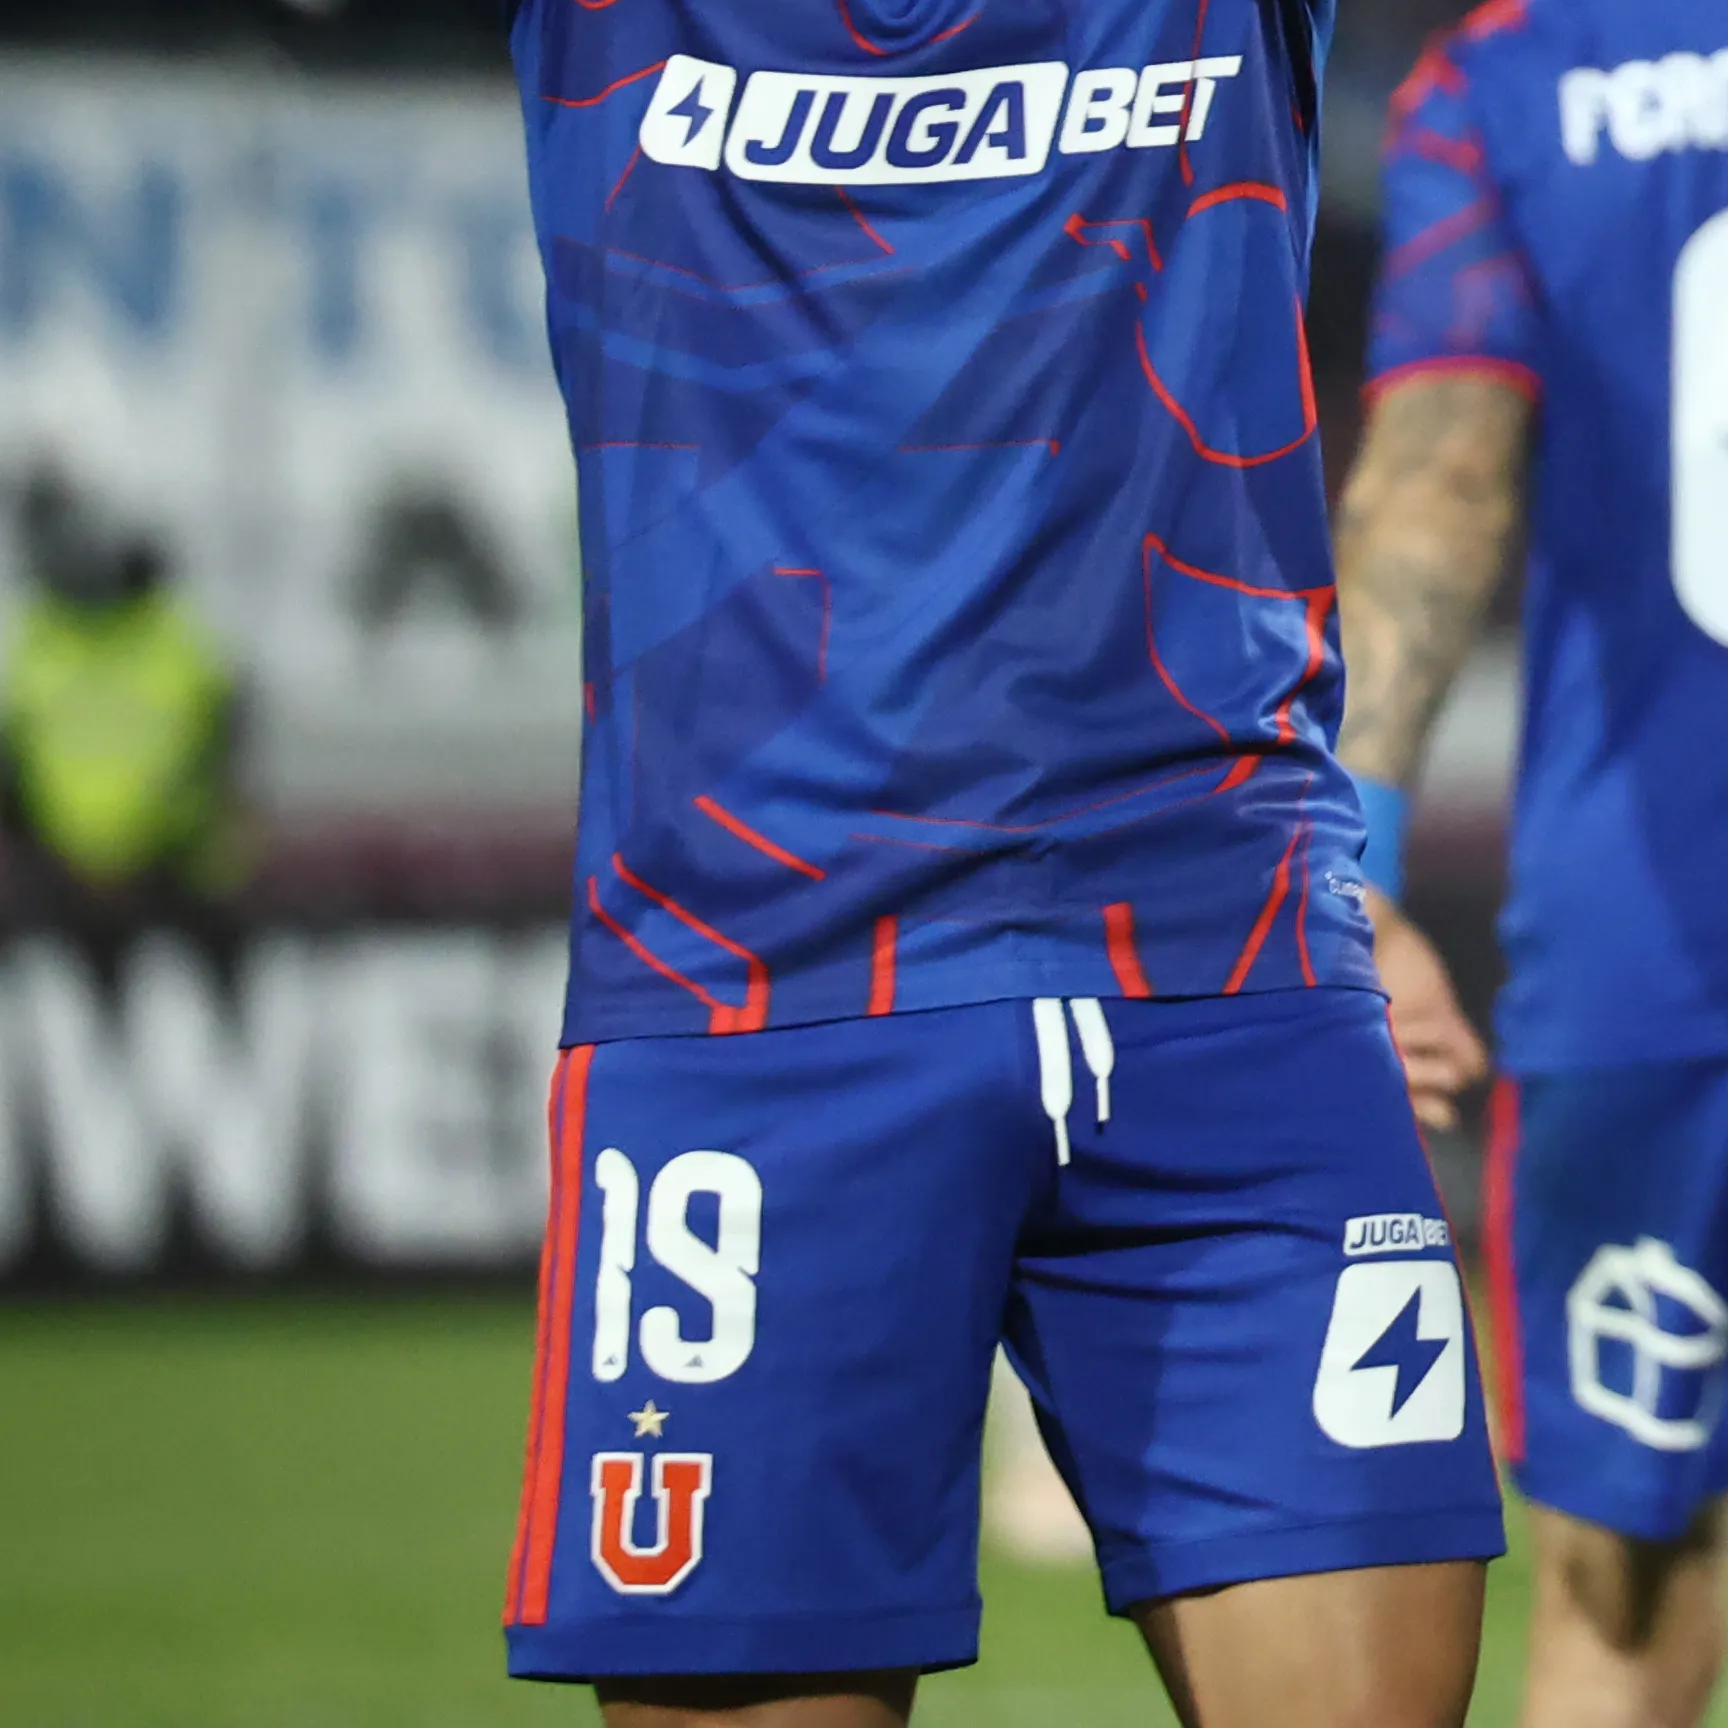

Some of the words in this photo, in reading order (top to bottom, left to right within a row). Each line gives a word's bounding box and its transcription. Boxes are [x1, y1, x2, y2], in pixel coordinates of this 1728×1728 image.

[744, 55, 1241, 167] JUGABET
[592, 1147, 762, 1384] 19
[591, 1452, 712, 1595] U
